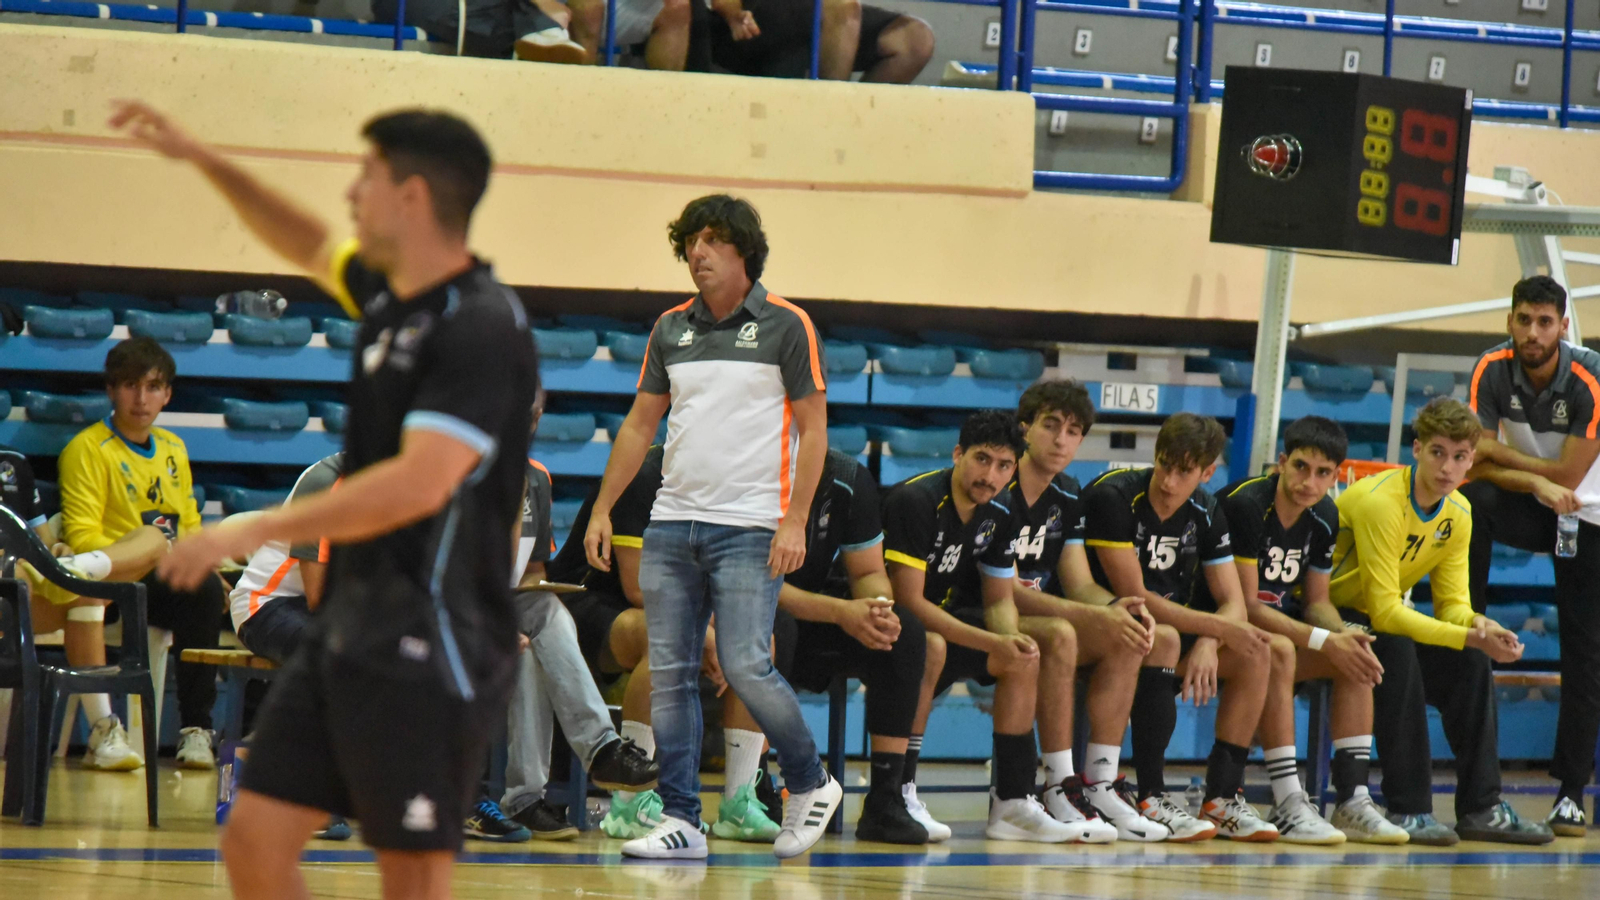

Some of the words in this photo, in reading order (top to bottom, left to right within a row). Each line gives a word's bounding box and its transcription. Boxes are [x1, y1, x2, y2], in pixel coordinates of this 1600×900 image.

[991, 28, 998, 41] 2
[1080, 34, 1088, 48] 3
[1055, 116, 1062, 130] 1
[1146, 122, 1154, 136] 2
[1103, 384, 1140, 408] FILA
[1145, 388, 1156, 410] 5
[1015, 525, 1047, 561] 44
[1146, 534, 1180, 570] 15
[1400, 534, 1426, 562] 71
[937, 544, 963, 573] 99
[1264, 546, 1302, 583] 35
